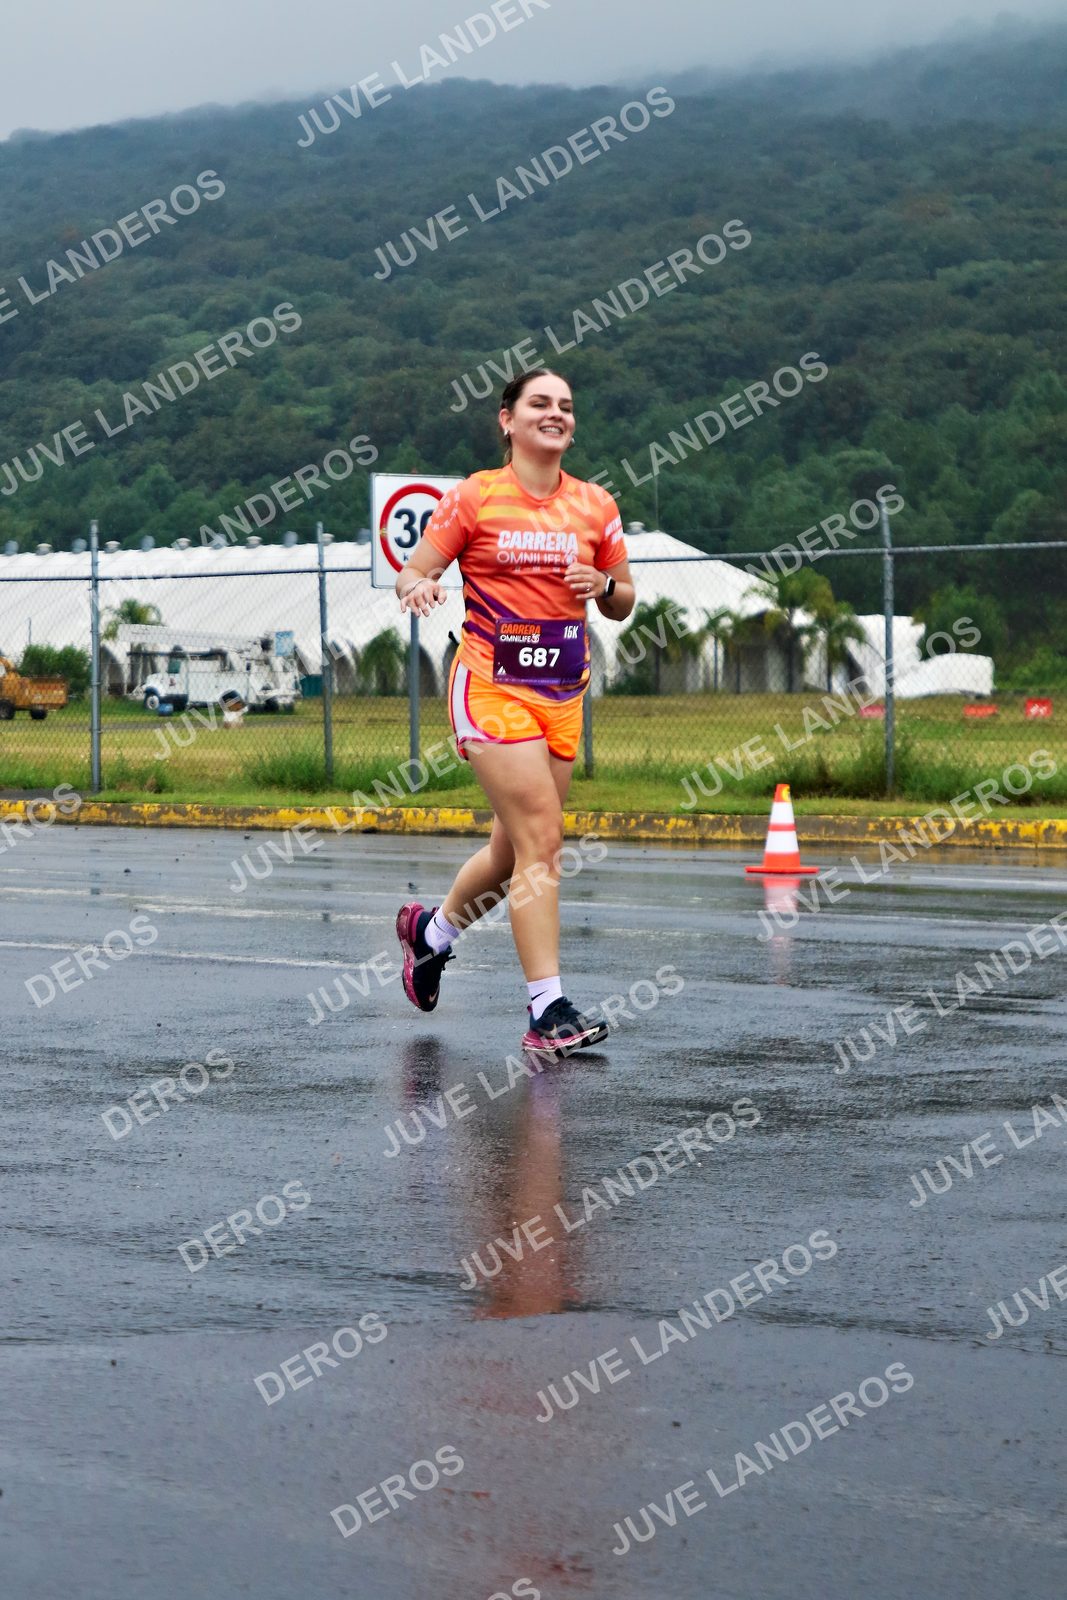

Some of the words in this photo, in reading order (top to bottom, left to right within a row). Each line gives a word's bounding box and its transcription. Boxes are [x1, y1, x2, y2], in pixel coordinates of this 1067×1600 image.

[497, 530, 578, 553] CARRERA
[500, 623, 541, 635] CARRERA
[518, 647, 560, 667] 687
